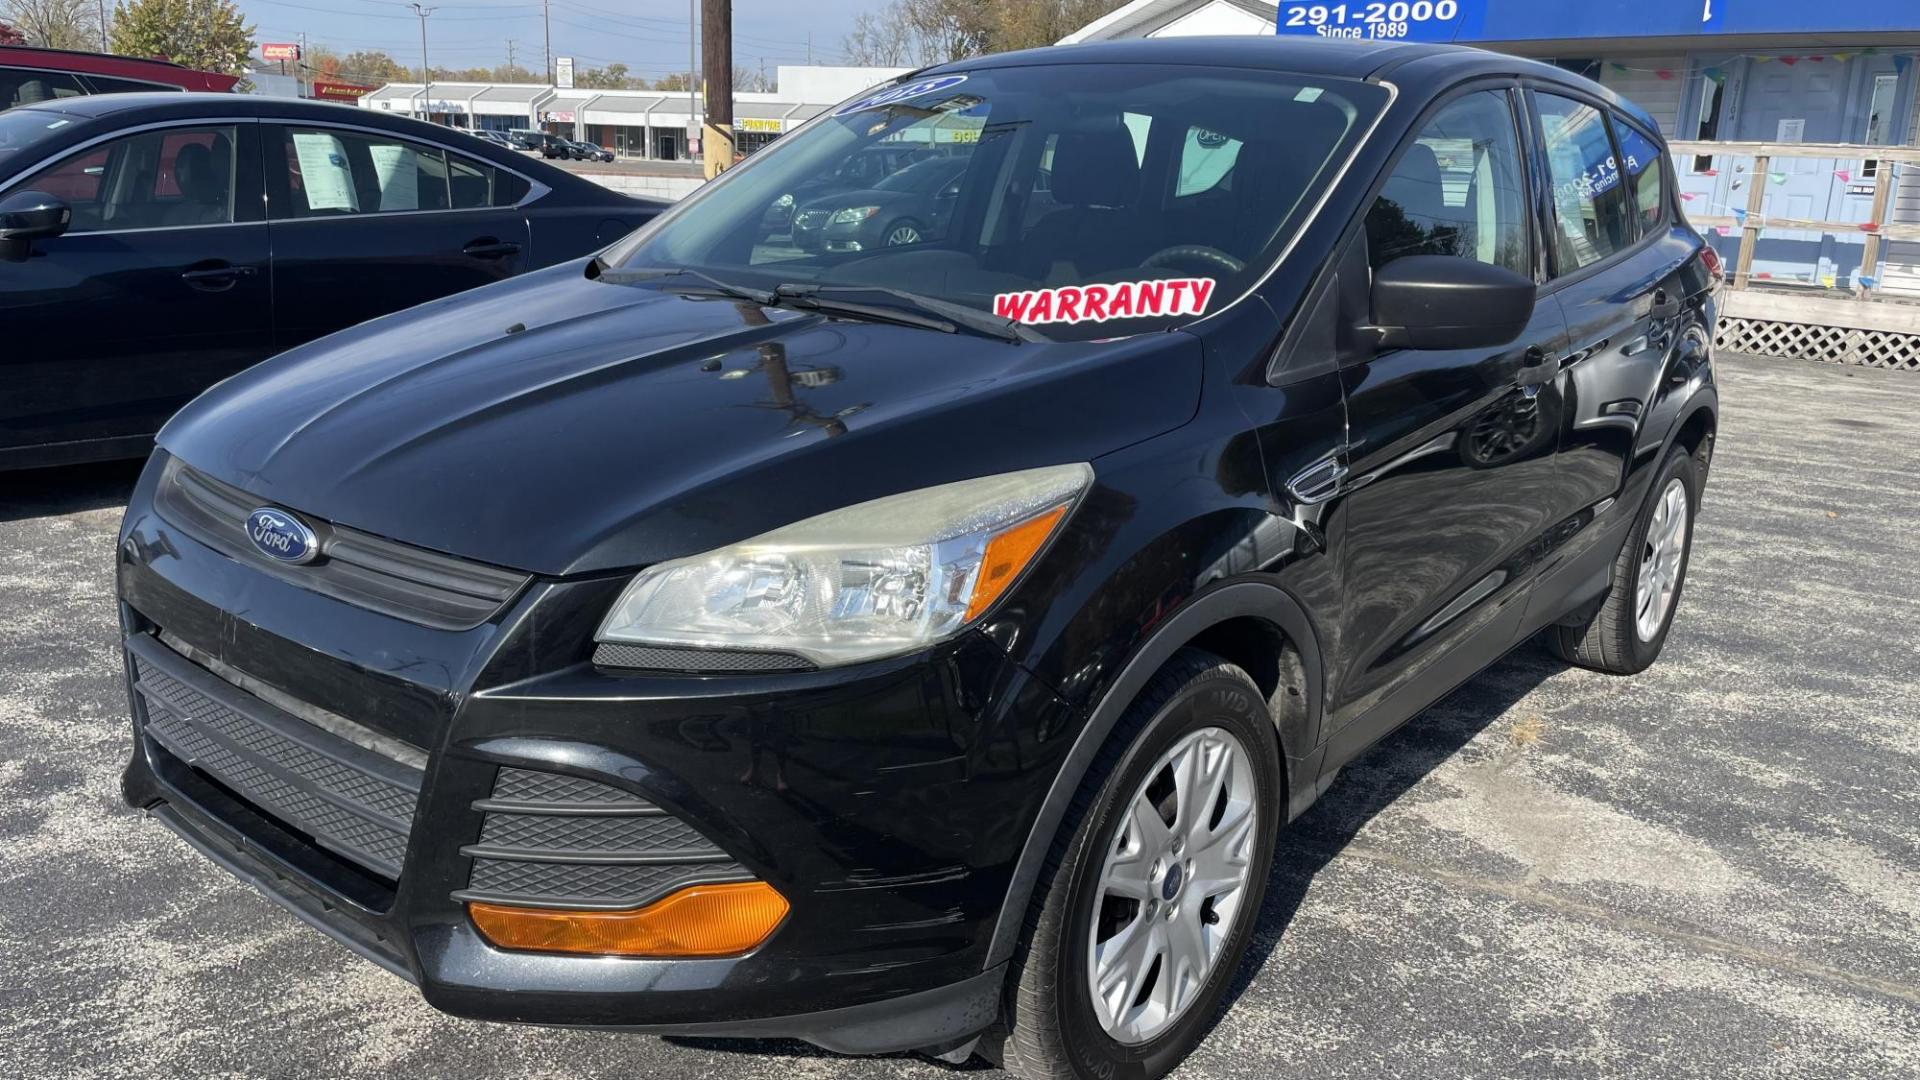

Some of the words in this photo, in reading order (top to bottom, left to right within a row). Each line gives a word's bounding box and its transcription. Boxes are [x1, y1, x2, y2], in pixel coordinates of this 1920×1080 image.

[1286, 0, 1457, 26] 291-2000
[1316, 24, 1362, 39] Since
[1367, 22, 1408, 40] 1989
[995, 279, 1213, 322] WARRANTY
[253, 514, 301, 553] Ford
